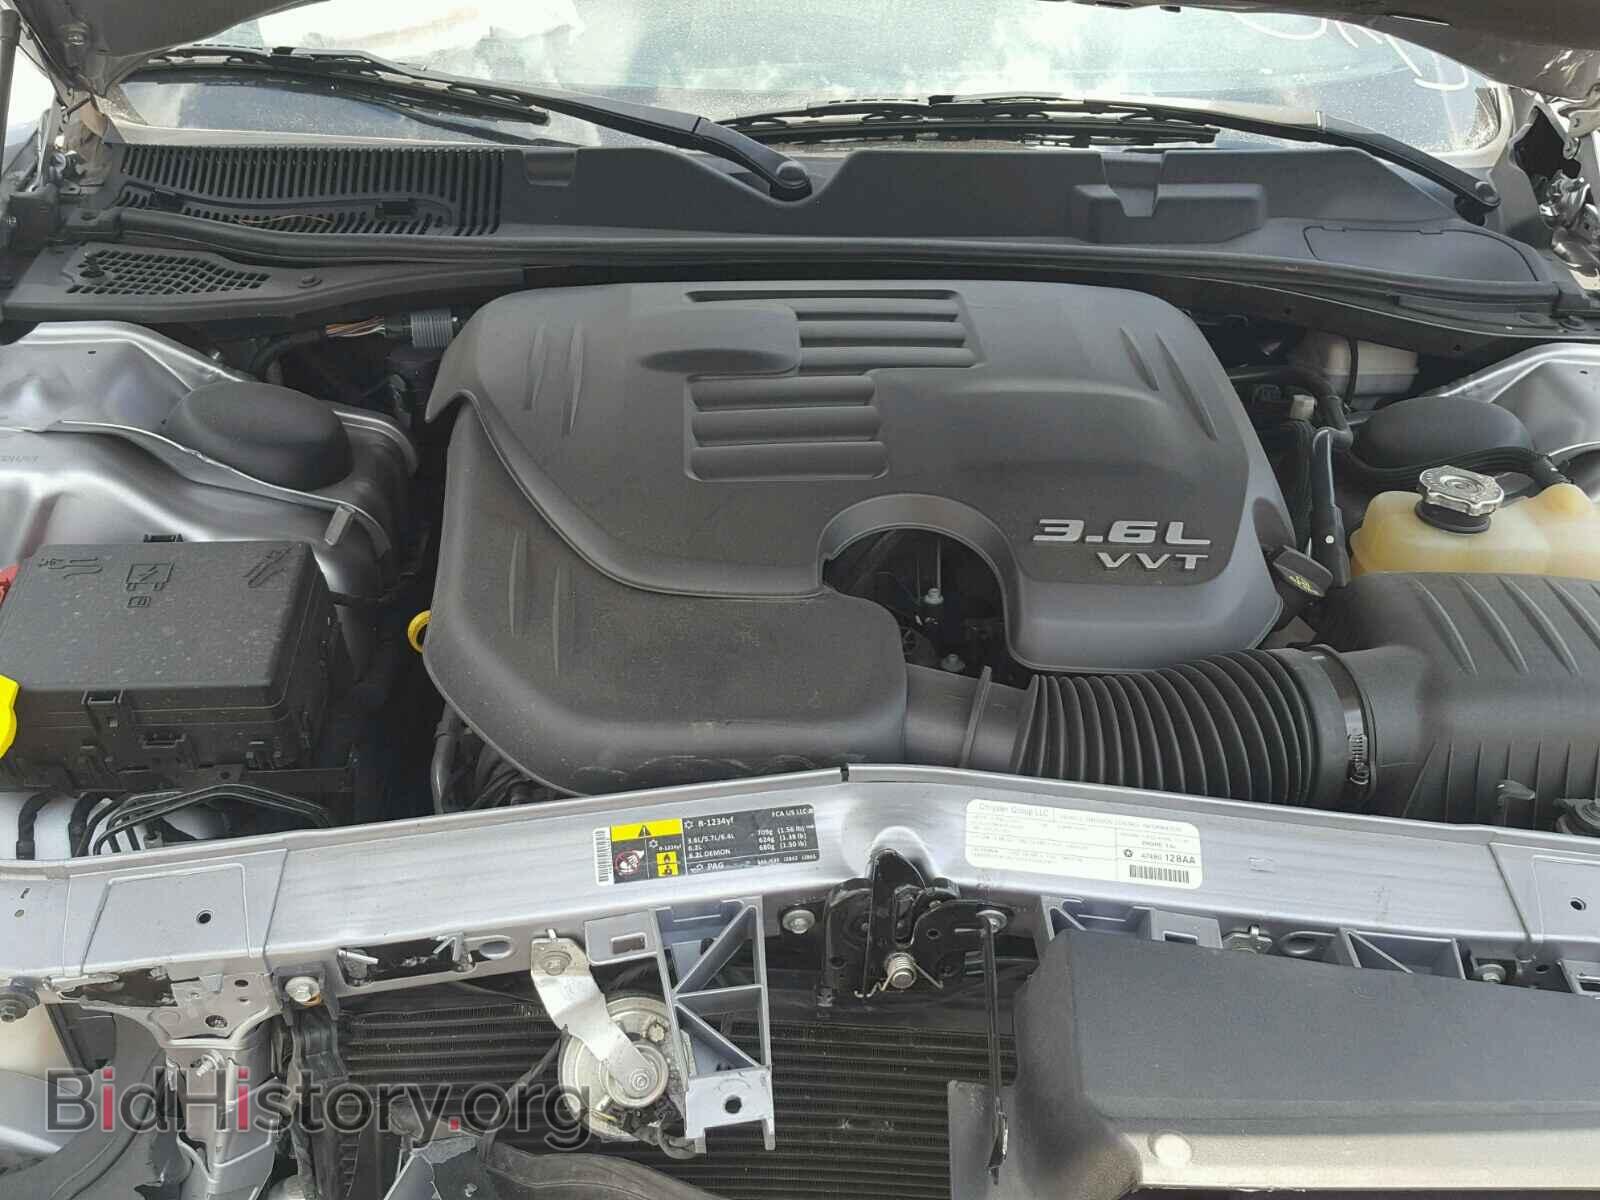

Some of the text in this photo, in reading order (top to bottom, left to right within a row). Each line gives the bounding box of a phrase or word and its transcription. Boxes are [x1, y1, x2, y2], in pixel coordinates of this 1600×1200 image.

[1032, 518, 1212, 546] 3.6L
[1096, 551, 1210, 570] VVT
[697, 816, 735, 828] R-1234yf
[1165, 853, 1197, 865] 128AA
[706, 861, 725, 871] PAG
